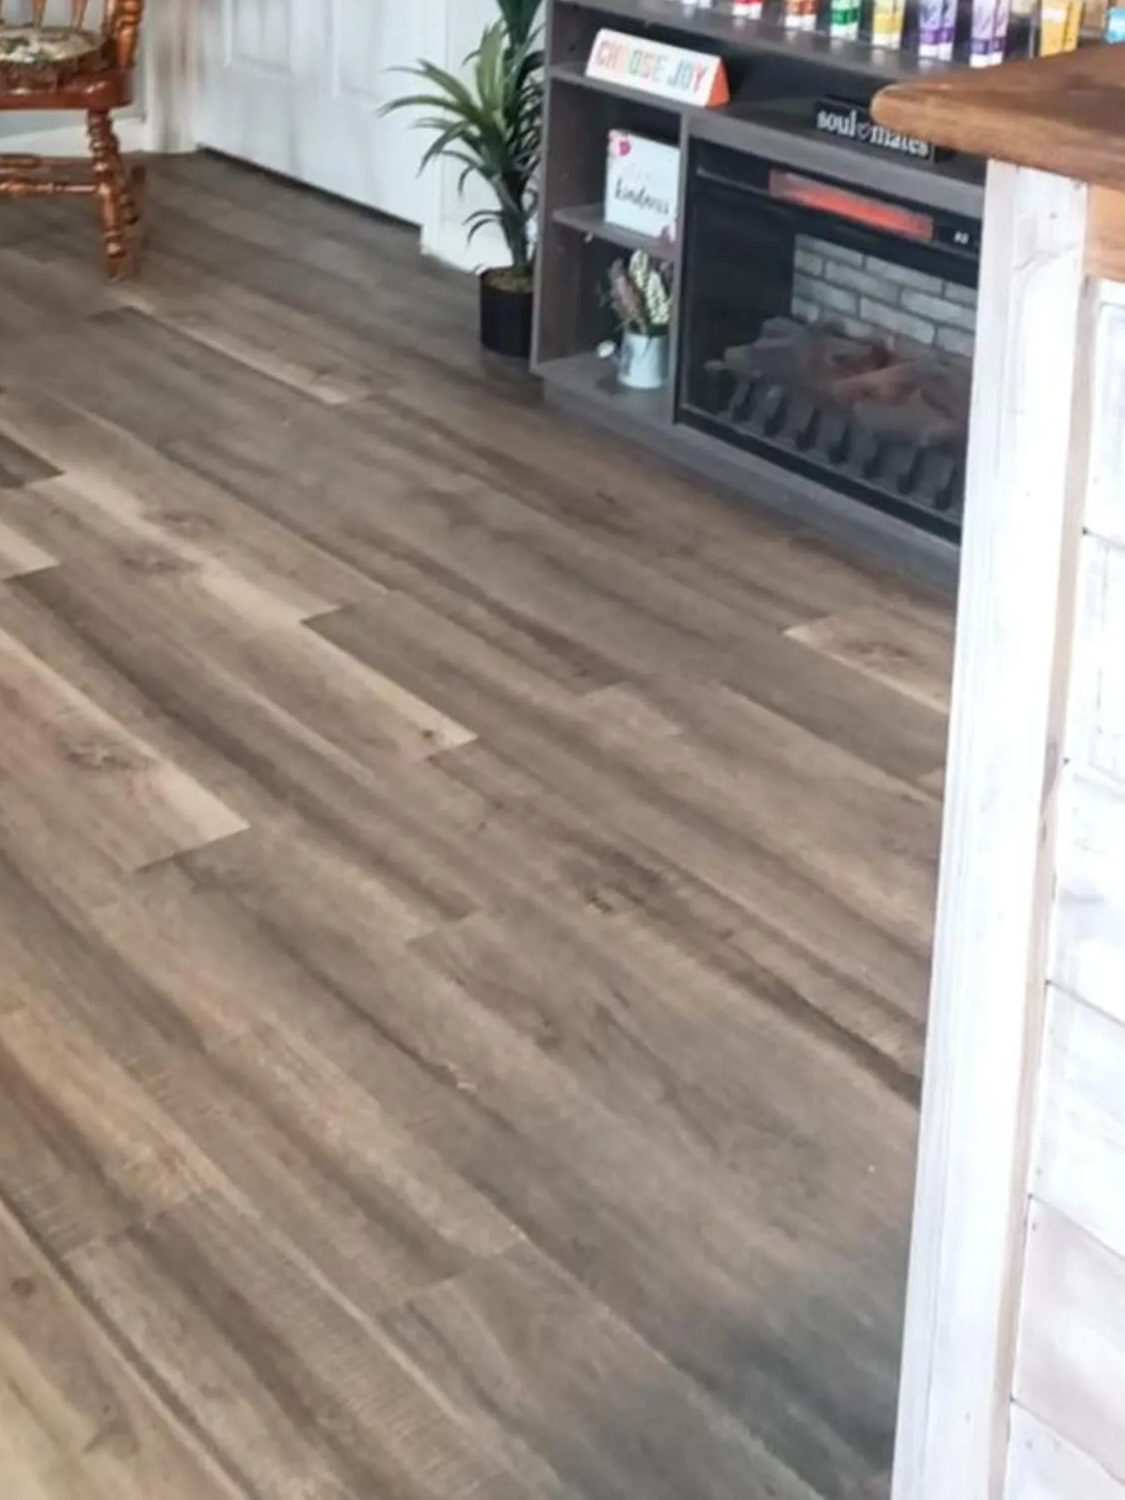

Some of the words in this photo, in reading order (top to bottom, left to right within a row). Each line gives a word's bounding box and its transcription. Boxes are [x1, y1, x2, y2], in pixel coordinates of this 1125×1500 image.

[666, 55, 708, 94] JOY
[816, 109, 858, 137] soul
[870, 124, 930, 158] mates
